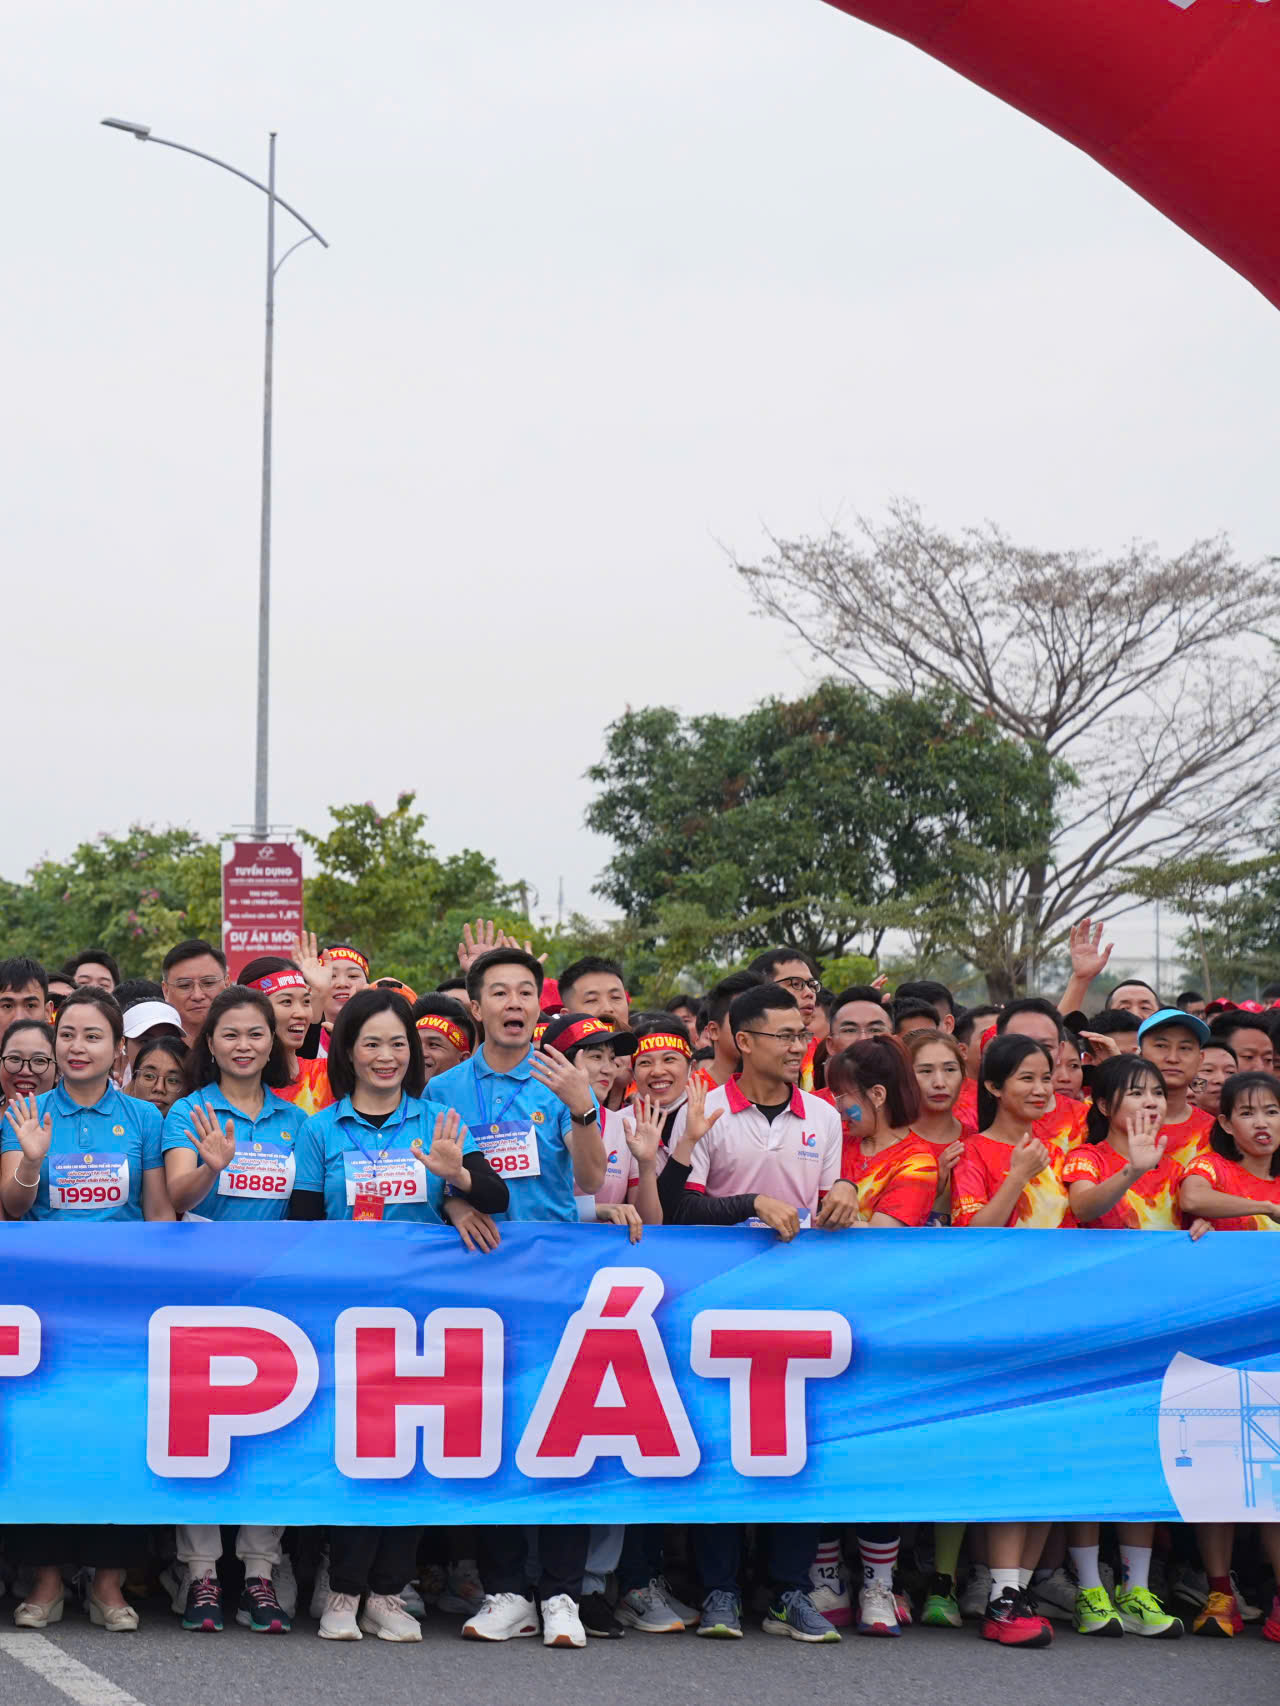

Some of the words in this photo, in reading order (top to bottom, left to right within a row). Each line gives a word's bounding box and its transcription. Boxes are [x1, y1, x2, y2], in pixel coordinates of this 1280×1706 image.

[230, 932, 249, 945] DỰ
[251, 929, 268, 942] ÁN
[640, 1036, 684, 1049] KYOWA
[486, 1154, 530, 1173] 983
[228, 1173, 287, 1192] 18882
[58, 1186, 121, 1203] 19990
[147, 1267, 852, 1478] PHÁT
